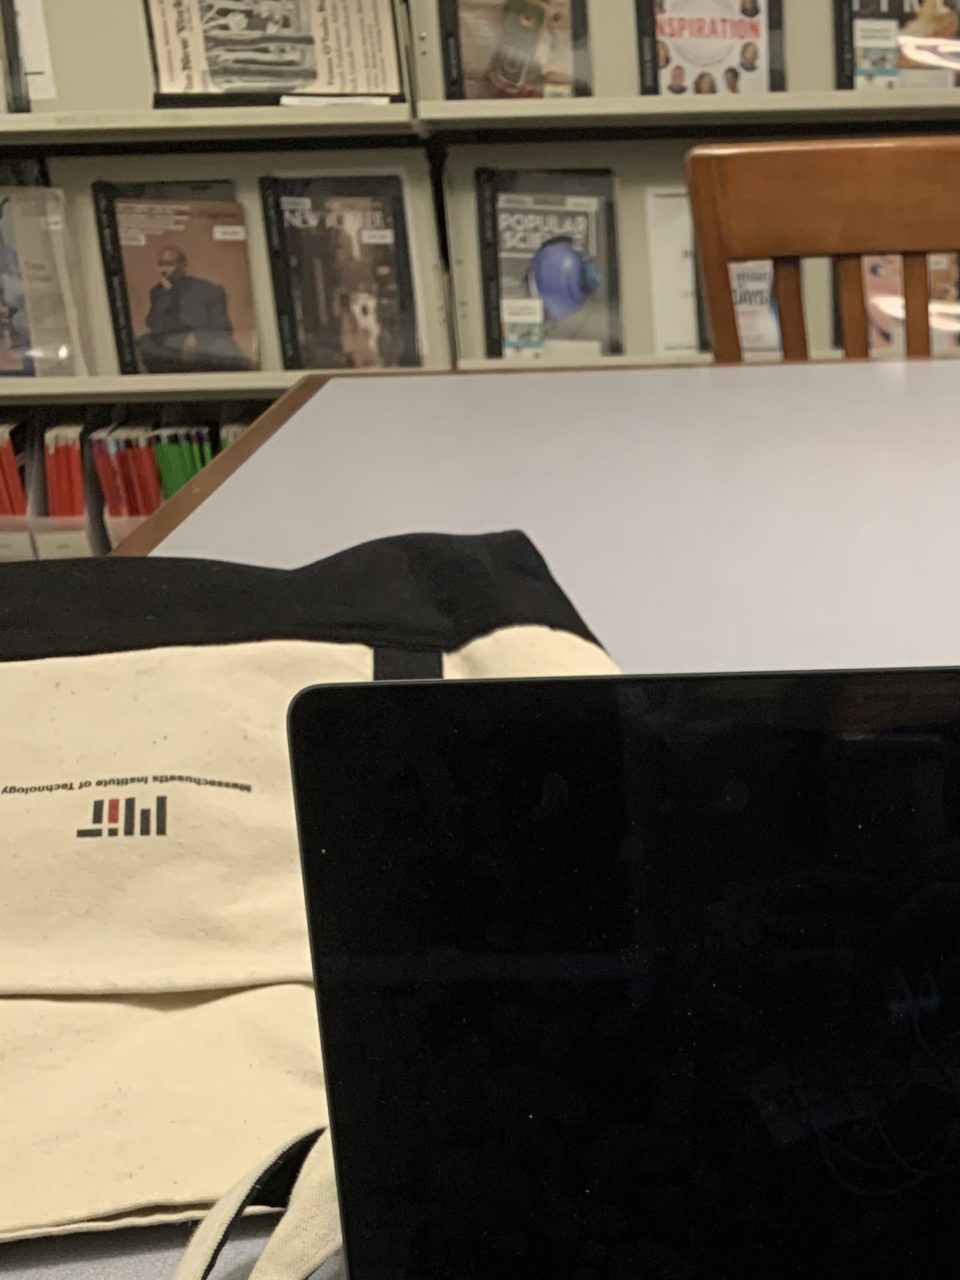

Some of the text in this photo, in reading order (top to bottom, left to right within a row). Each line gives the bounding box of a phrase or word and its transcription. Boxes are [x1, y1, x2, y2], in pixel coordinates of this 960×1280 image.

[499, 212, 588, 234] POPULAR
[0, 773, 252, 796] Massachusetts Institute of Technology
